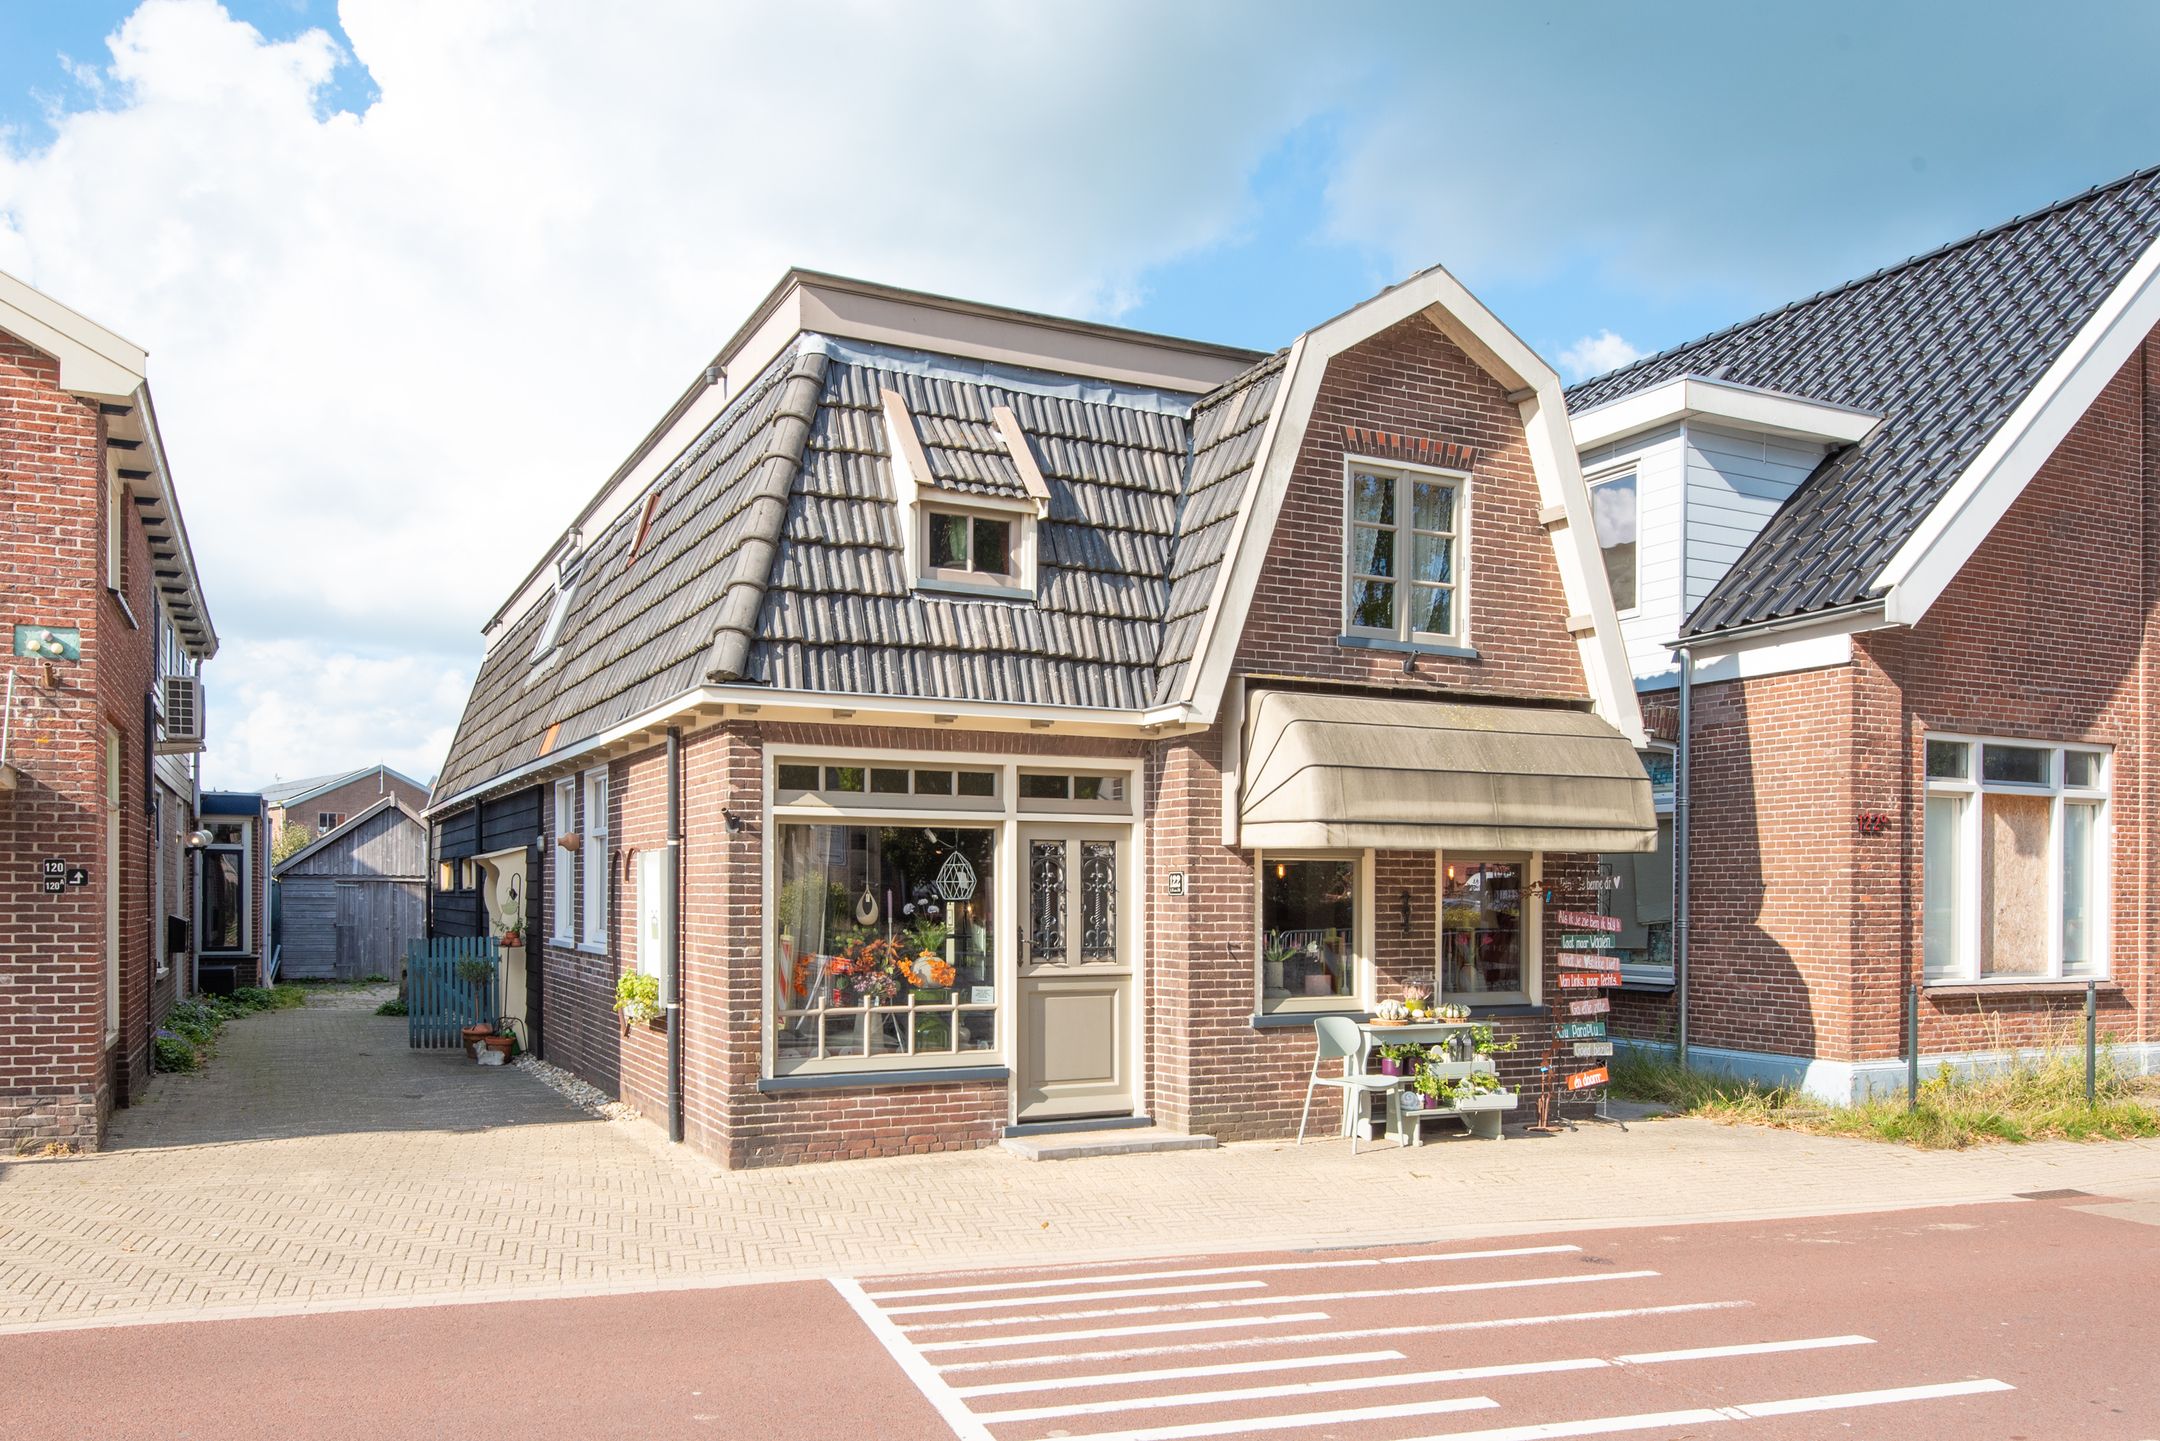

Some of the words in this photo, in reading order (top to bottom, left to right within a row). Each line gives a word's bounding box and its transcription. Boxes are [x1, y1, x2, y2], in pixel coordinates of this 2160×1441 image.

[45, 862, 64, 873] 120
[45, 878, 65, 891] 120A
[1169, 874, 1181, 887] 122
[1559, 973, 1571, 988] Van
[1586, 976, 1600, 988] naar
